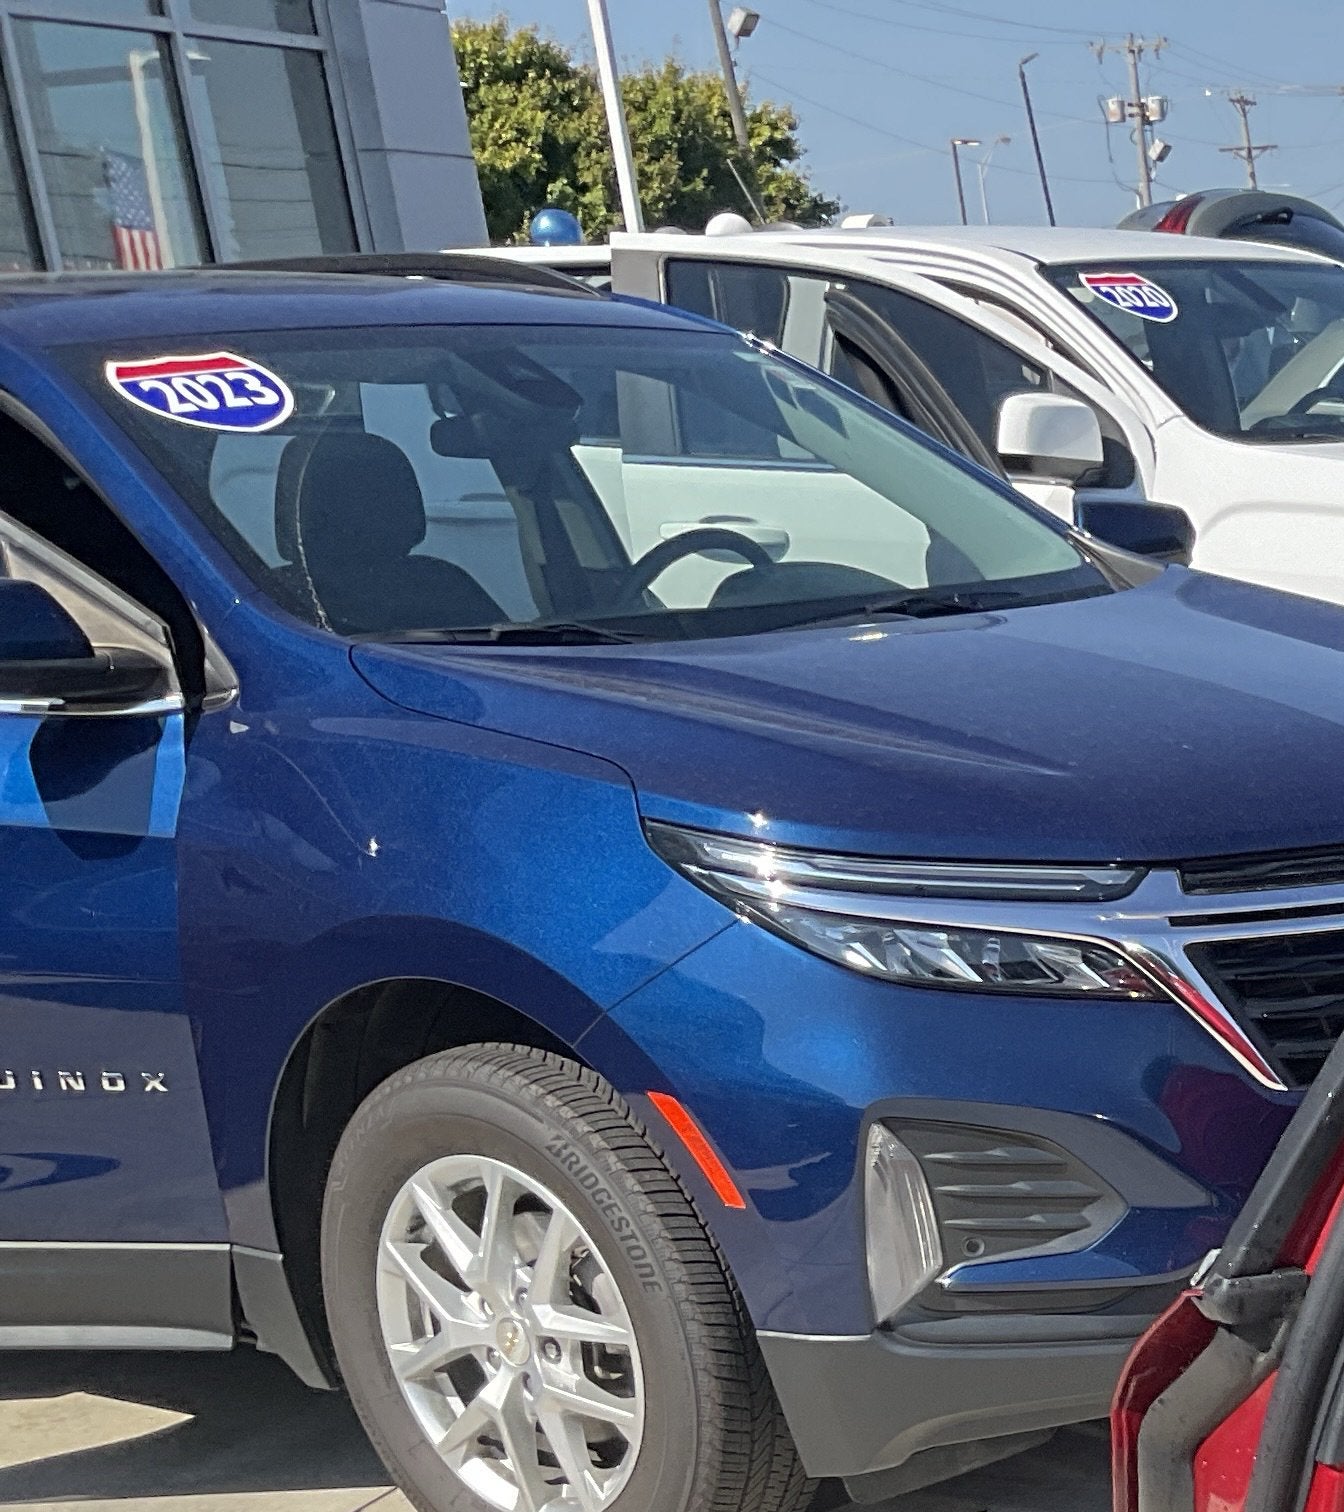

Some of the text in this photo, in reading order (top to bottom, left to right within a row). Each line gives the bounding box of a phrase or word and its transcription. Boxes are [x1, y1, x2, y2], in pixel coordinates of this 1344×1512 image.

[1100, 286, 1171, 309] 2020
[139, 371, 280, 414] 2023
[545, 1135, 662, 1294] BRIDGESTONE
